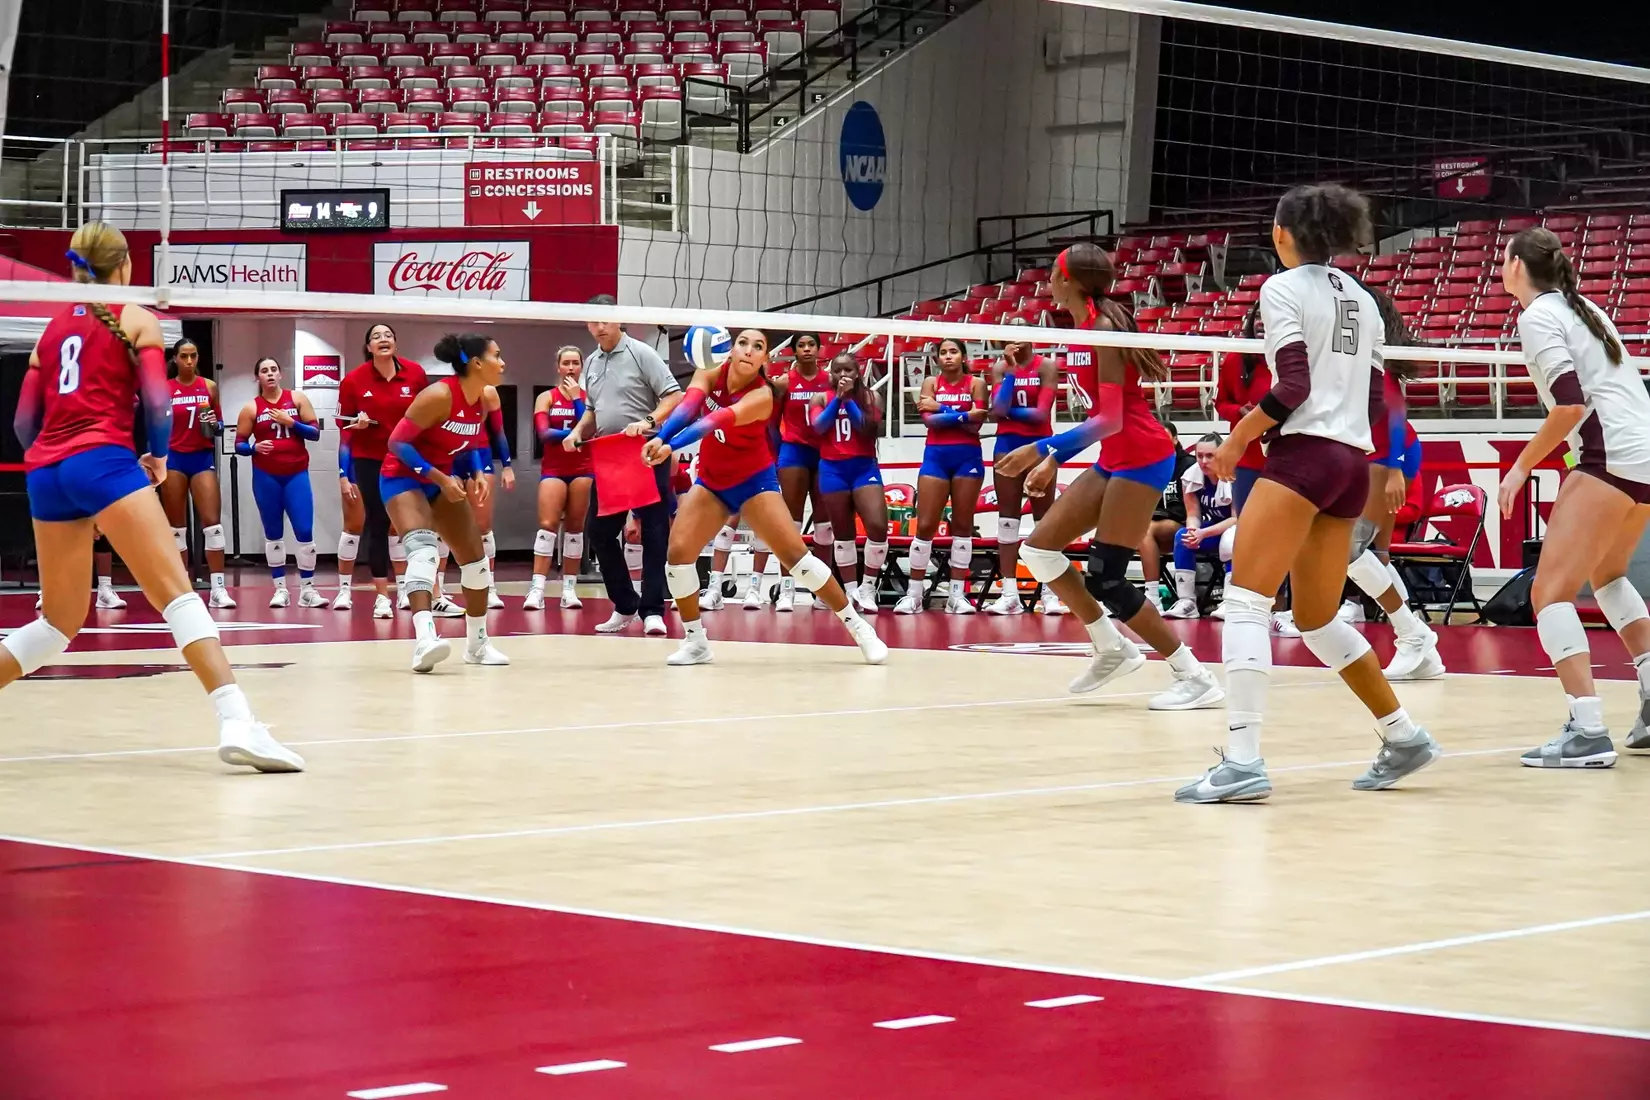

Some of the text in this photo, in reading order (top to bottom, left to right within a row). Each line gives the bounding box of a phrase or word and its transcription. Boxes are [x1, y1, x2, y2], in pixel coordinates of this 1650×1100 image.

[815, 94, 822, 103] 5
[777, 117, 785, 126] 4
[484, 167, 579, 180] RESTROOMS
[845, 154, 887, 184] NCAA
[484, 184, 593, 197] CONCESSIONS
[316, 202, 330, 220] 14
[368, 202, 378, 219] 9
[388, 252, 514, 291] Coca-Cola
[1332, 296, 1360, 356] 15
[58, 335, 83, 395] 8
[186, 406, 196, 429] 7
[835, 418, 851, 442] 19
[938, 523, 948, 536] G
